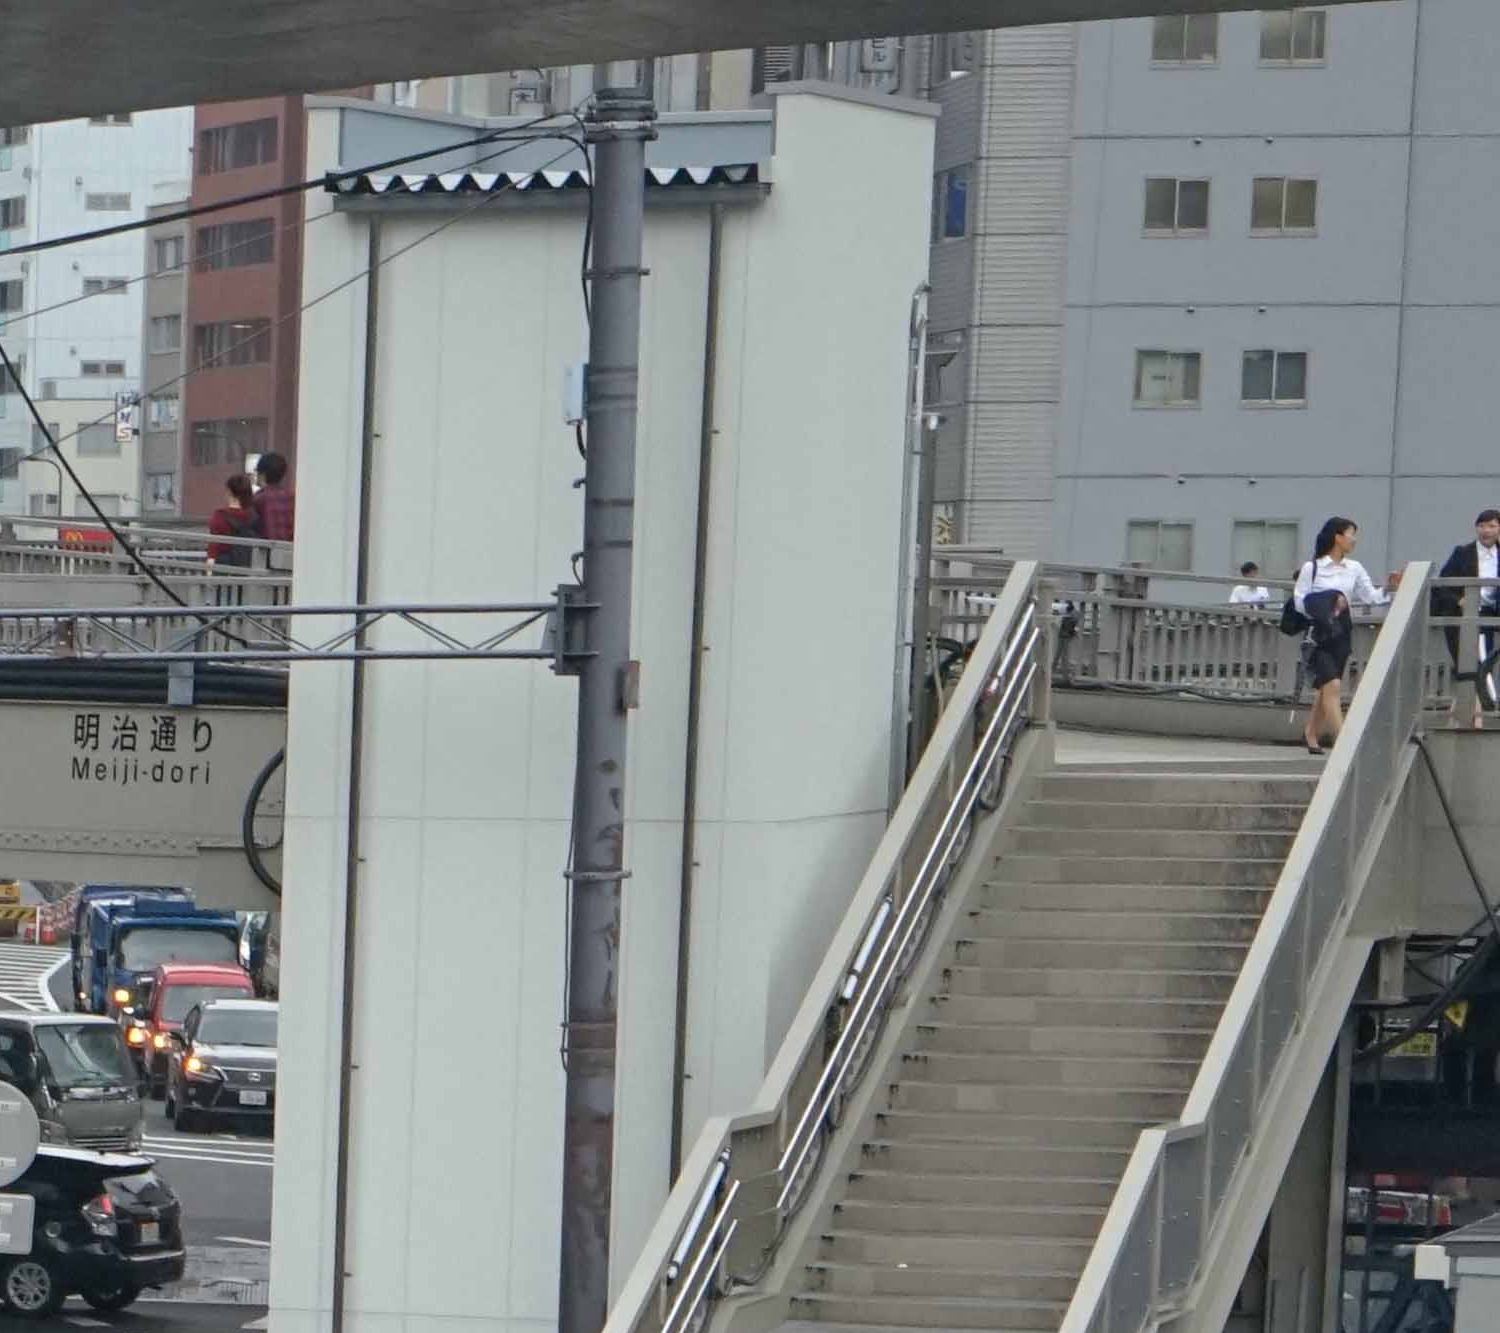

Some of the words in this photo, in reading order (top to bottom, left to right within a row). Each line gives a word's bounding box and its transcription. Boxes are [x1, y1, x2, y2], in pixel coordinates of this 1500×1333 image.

[74, 713, 213, 752] 明治通り
[71, 756, 211, 786] Meiji-dori
